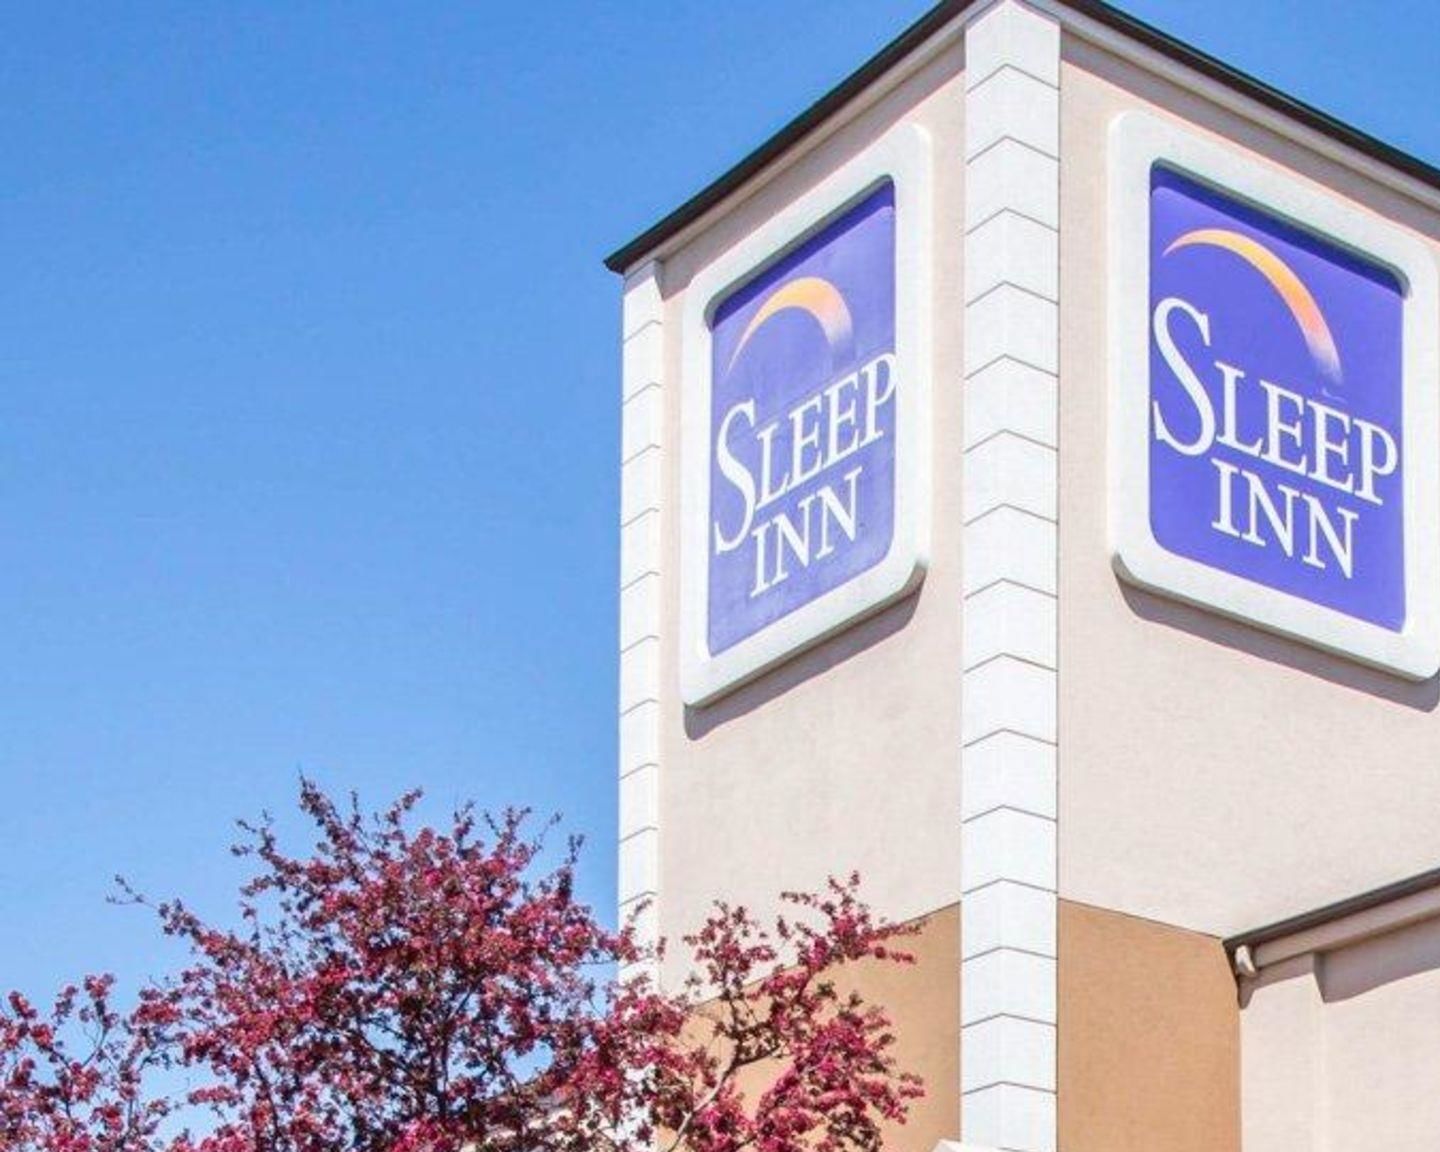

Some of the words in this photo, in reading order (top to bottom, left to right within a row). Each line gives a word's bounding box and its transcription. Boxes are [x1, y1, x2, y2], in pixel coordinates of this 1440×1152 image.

[714, 353, 897, 555] SLEEP
[1153, 298, 1398, 506] SLEEP
[751, 467, 863, 598] INN
[1211, 458, 1359, 579] INN
